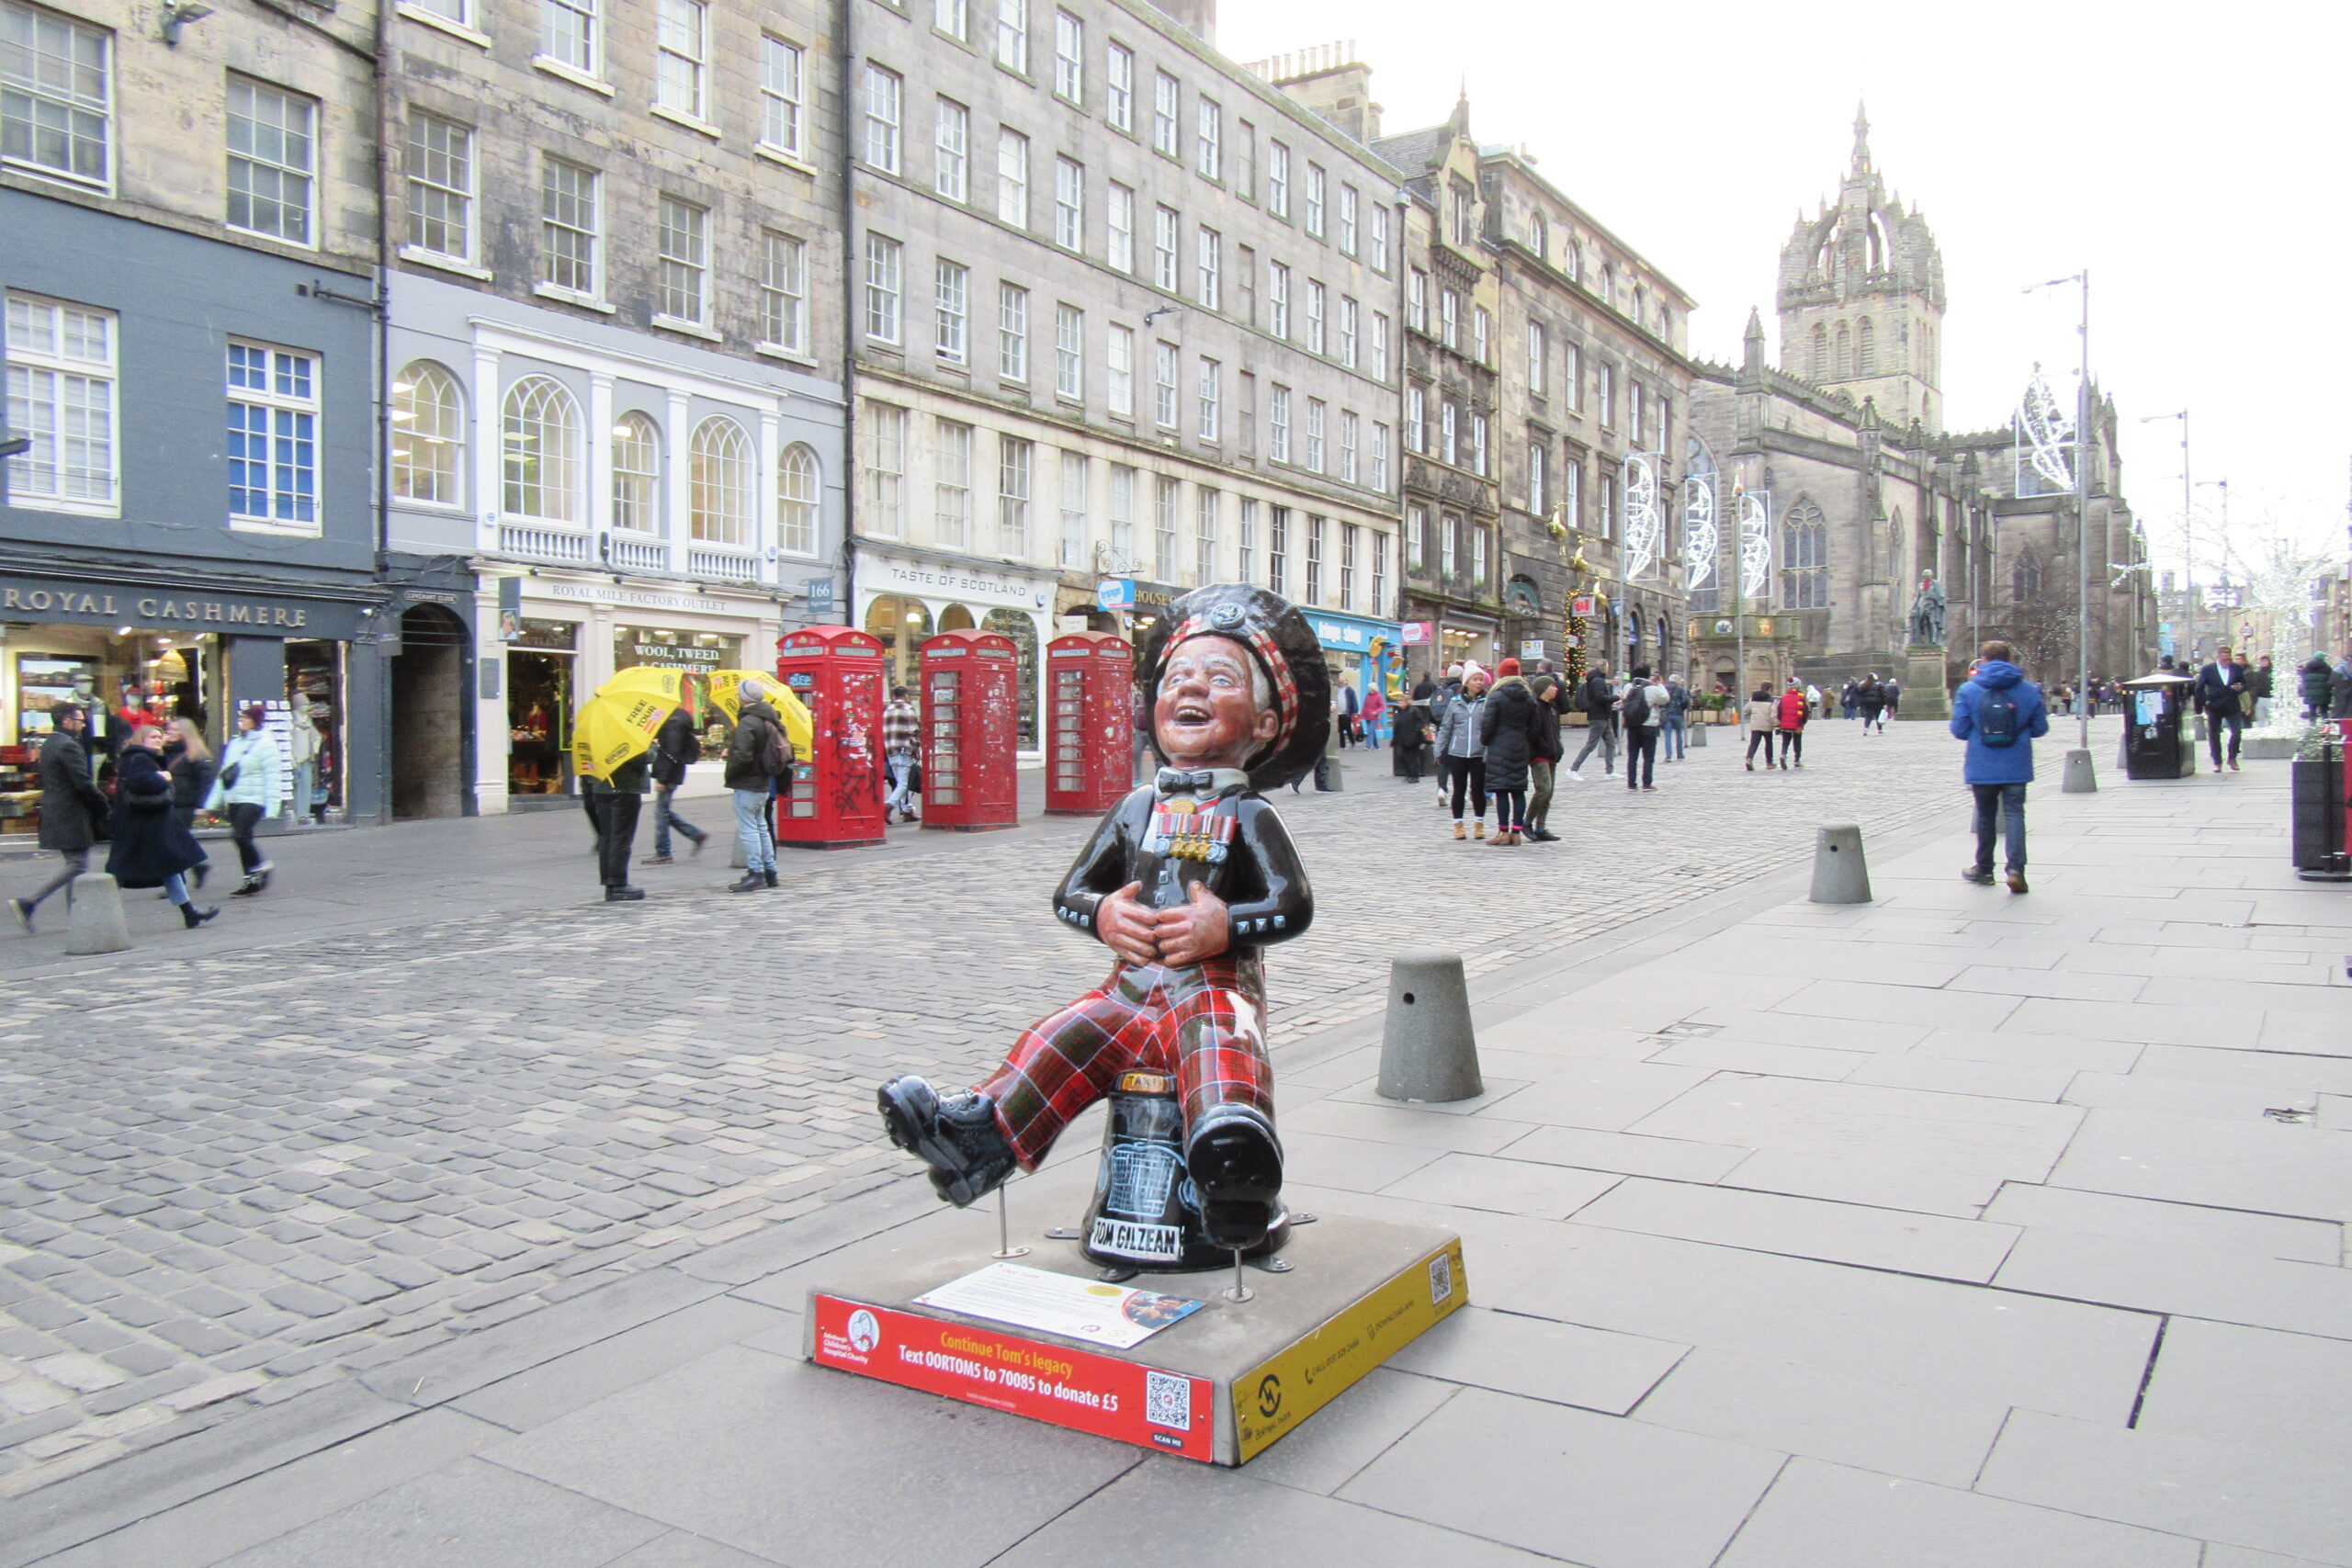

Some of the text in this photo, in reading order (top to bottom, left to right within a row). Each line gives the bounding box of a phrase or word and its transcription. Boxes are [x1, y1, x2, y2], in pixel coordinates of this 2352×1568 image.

[811, 584, 830, 598] 166
[891, 569, 1026, 596] TASTE OF SCOTLAND
[3, 588, 306, 627] ROYAL CASHMERE
[553, 585, 728, 611] ROYAL MILE FACTORY OUTLET
[1135, 590, 1169, 606] HOUSE
[634, 645, 719, 660] WOOL, TWEED
[626, 699, 648, 724] FREE
[637, 705, 657, 728] TOUR
[1129, 1075, 1159, 1088] TAXI
[1093, 1222, 1176, 1254] TOM GILZEAN
[847, 1352, 868, 1365] Charity
[941, 1331, 1073, 1380] Continue Tom's legacy
[899, 1344, 925, 1365] Text
[983, 1365, 997, 1382] to
[999, 1368, 1035, 1392] 70085
[1037, 1379, 1052, 1395] to
[1054, 1382, 1100, 1407] donate
[1102, 1393, 1119, 1412] £5
[1154, 1434, 1182, 1448] SCAN ME
